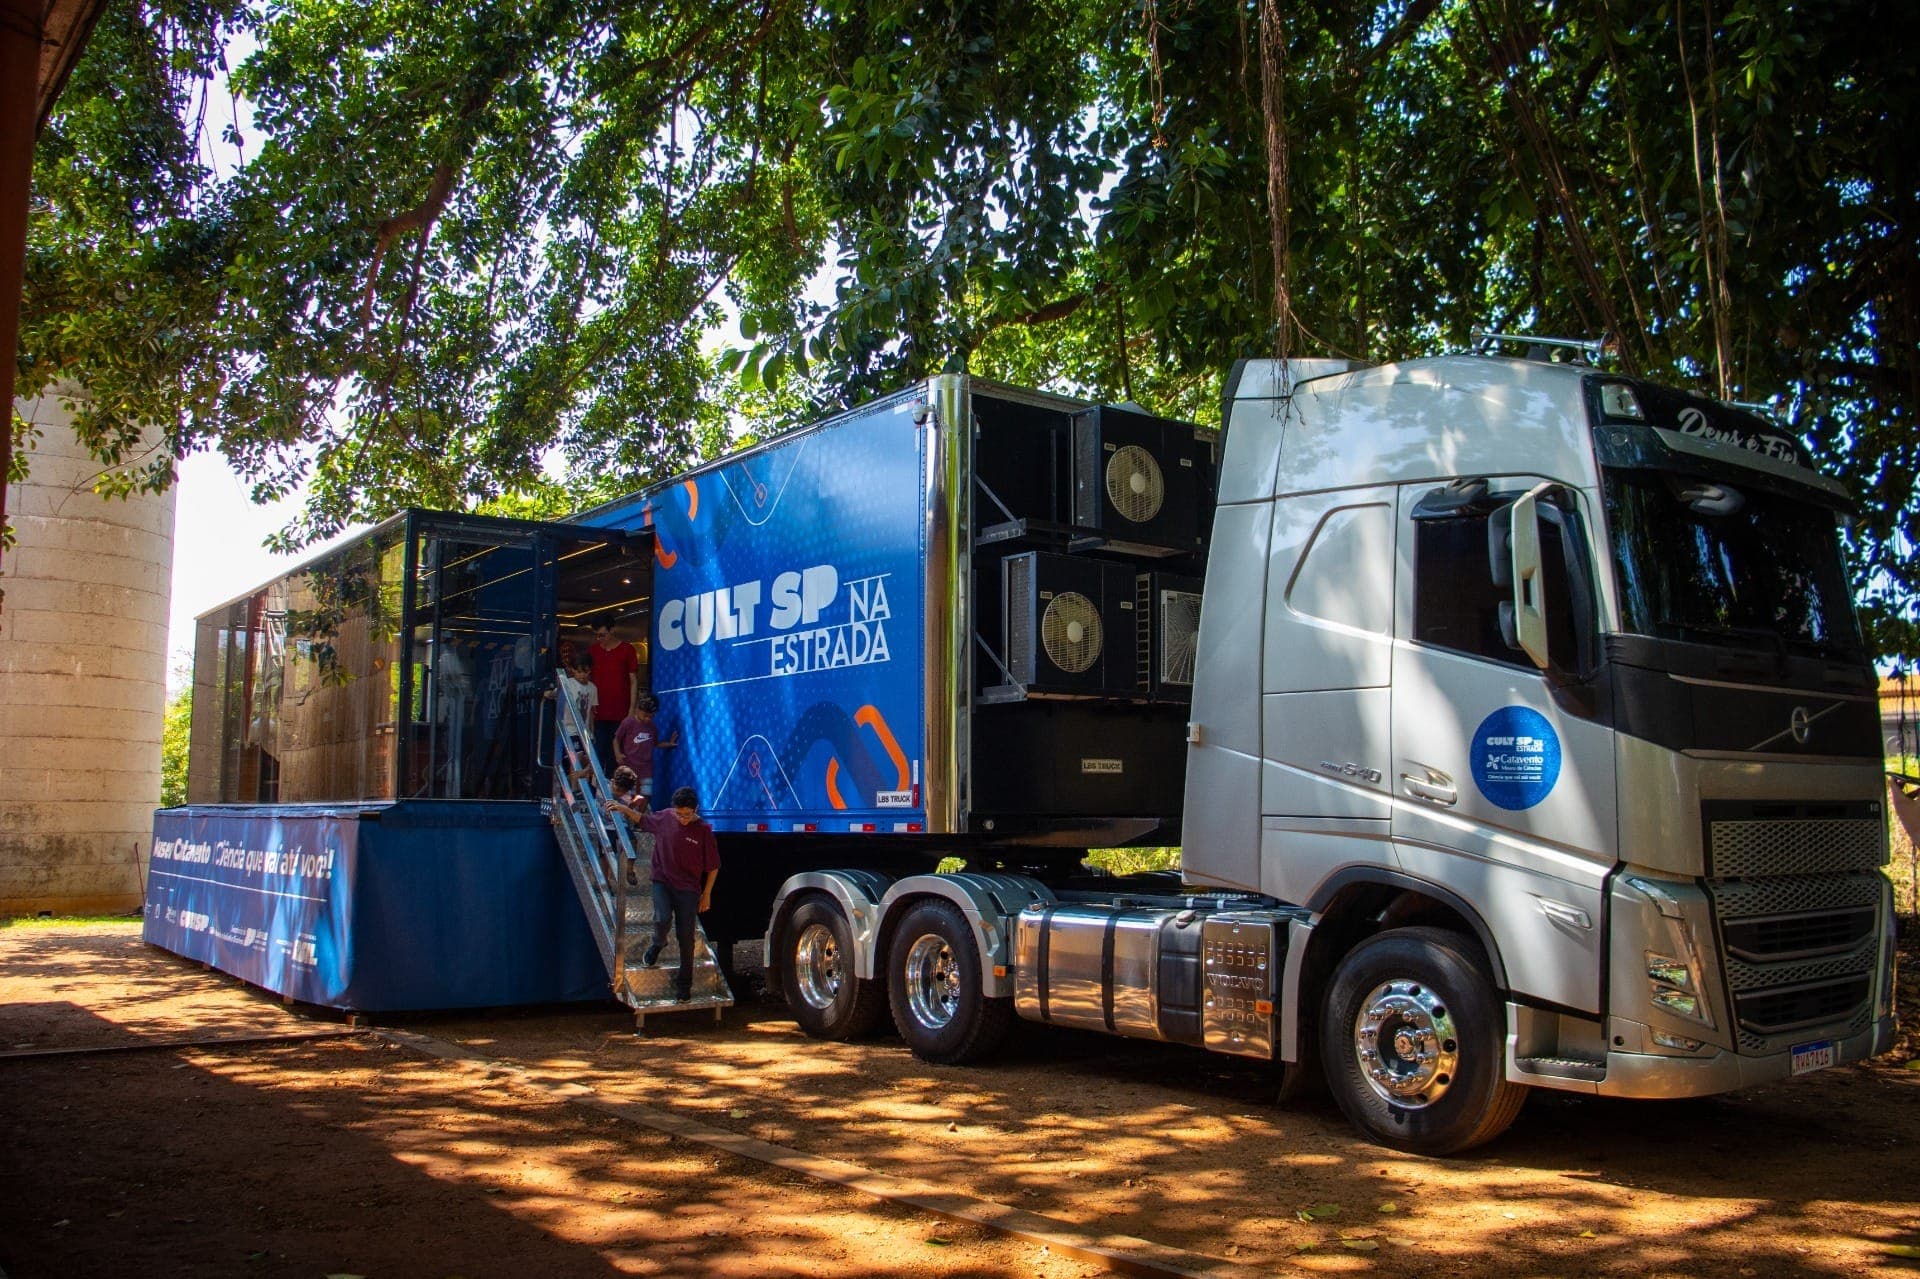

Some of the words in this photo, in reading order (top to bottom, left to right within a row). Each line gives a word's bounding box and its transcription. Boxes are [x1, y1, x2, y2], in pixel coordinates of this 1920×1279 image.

[1677, 407, 1743, 447] Deus
[1759, 434, 1798, 464] Fiel
[658, 580, 761, 651] CULT
[769, 564, 838, 630] SP
[850, 576, 891, 624] NA
[771, 619, 891, 676] ESTRADA
[1486, 736, 1515, 746] CULT
[1516, 736, 1533, 745] SP
[1500, 753, 1544, 764] Catavento
[1343, 761, 1382, 784] 540
[877, 795, 890, 804] LBS
[890, 794, 911, 804] TRUCK
[246, 850, 263, 877] que
[264, 844, 283, 873] vai
[1207, 972, 1265, 991] VOLVO
